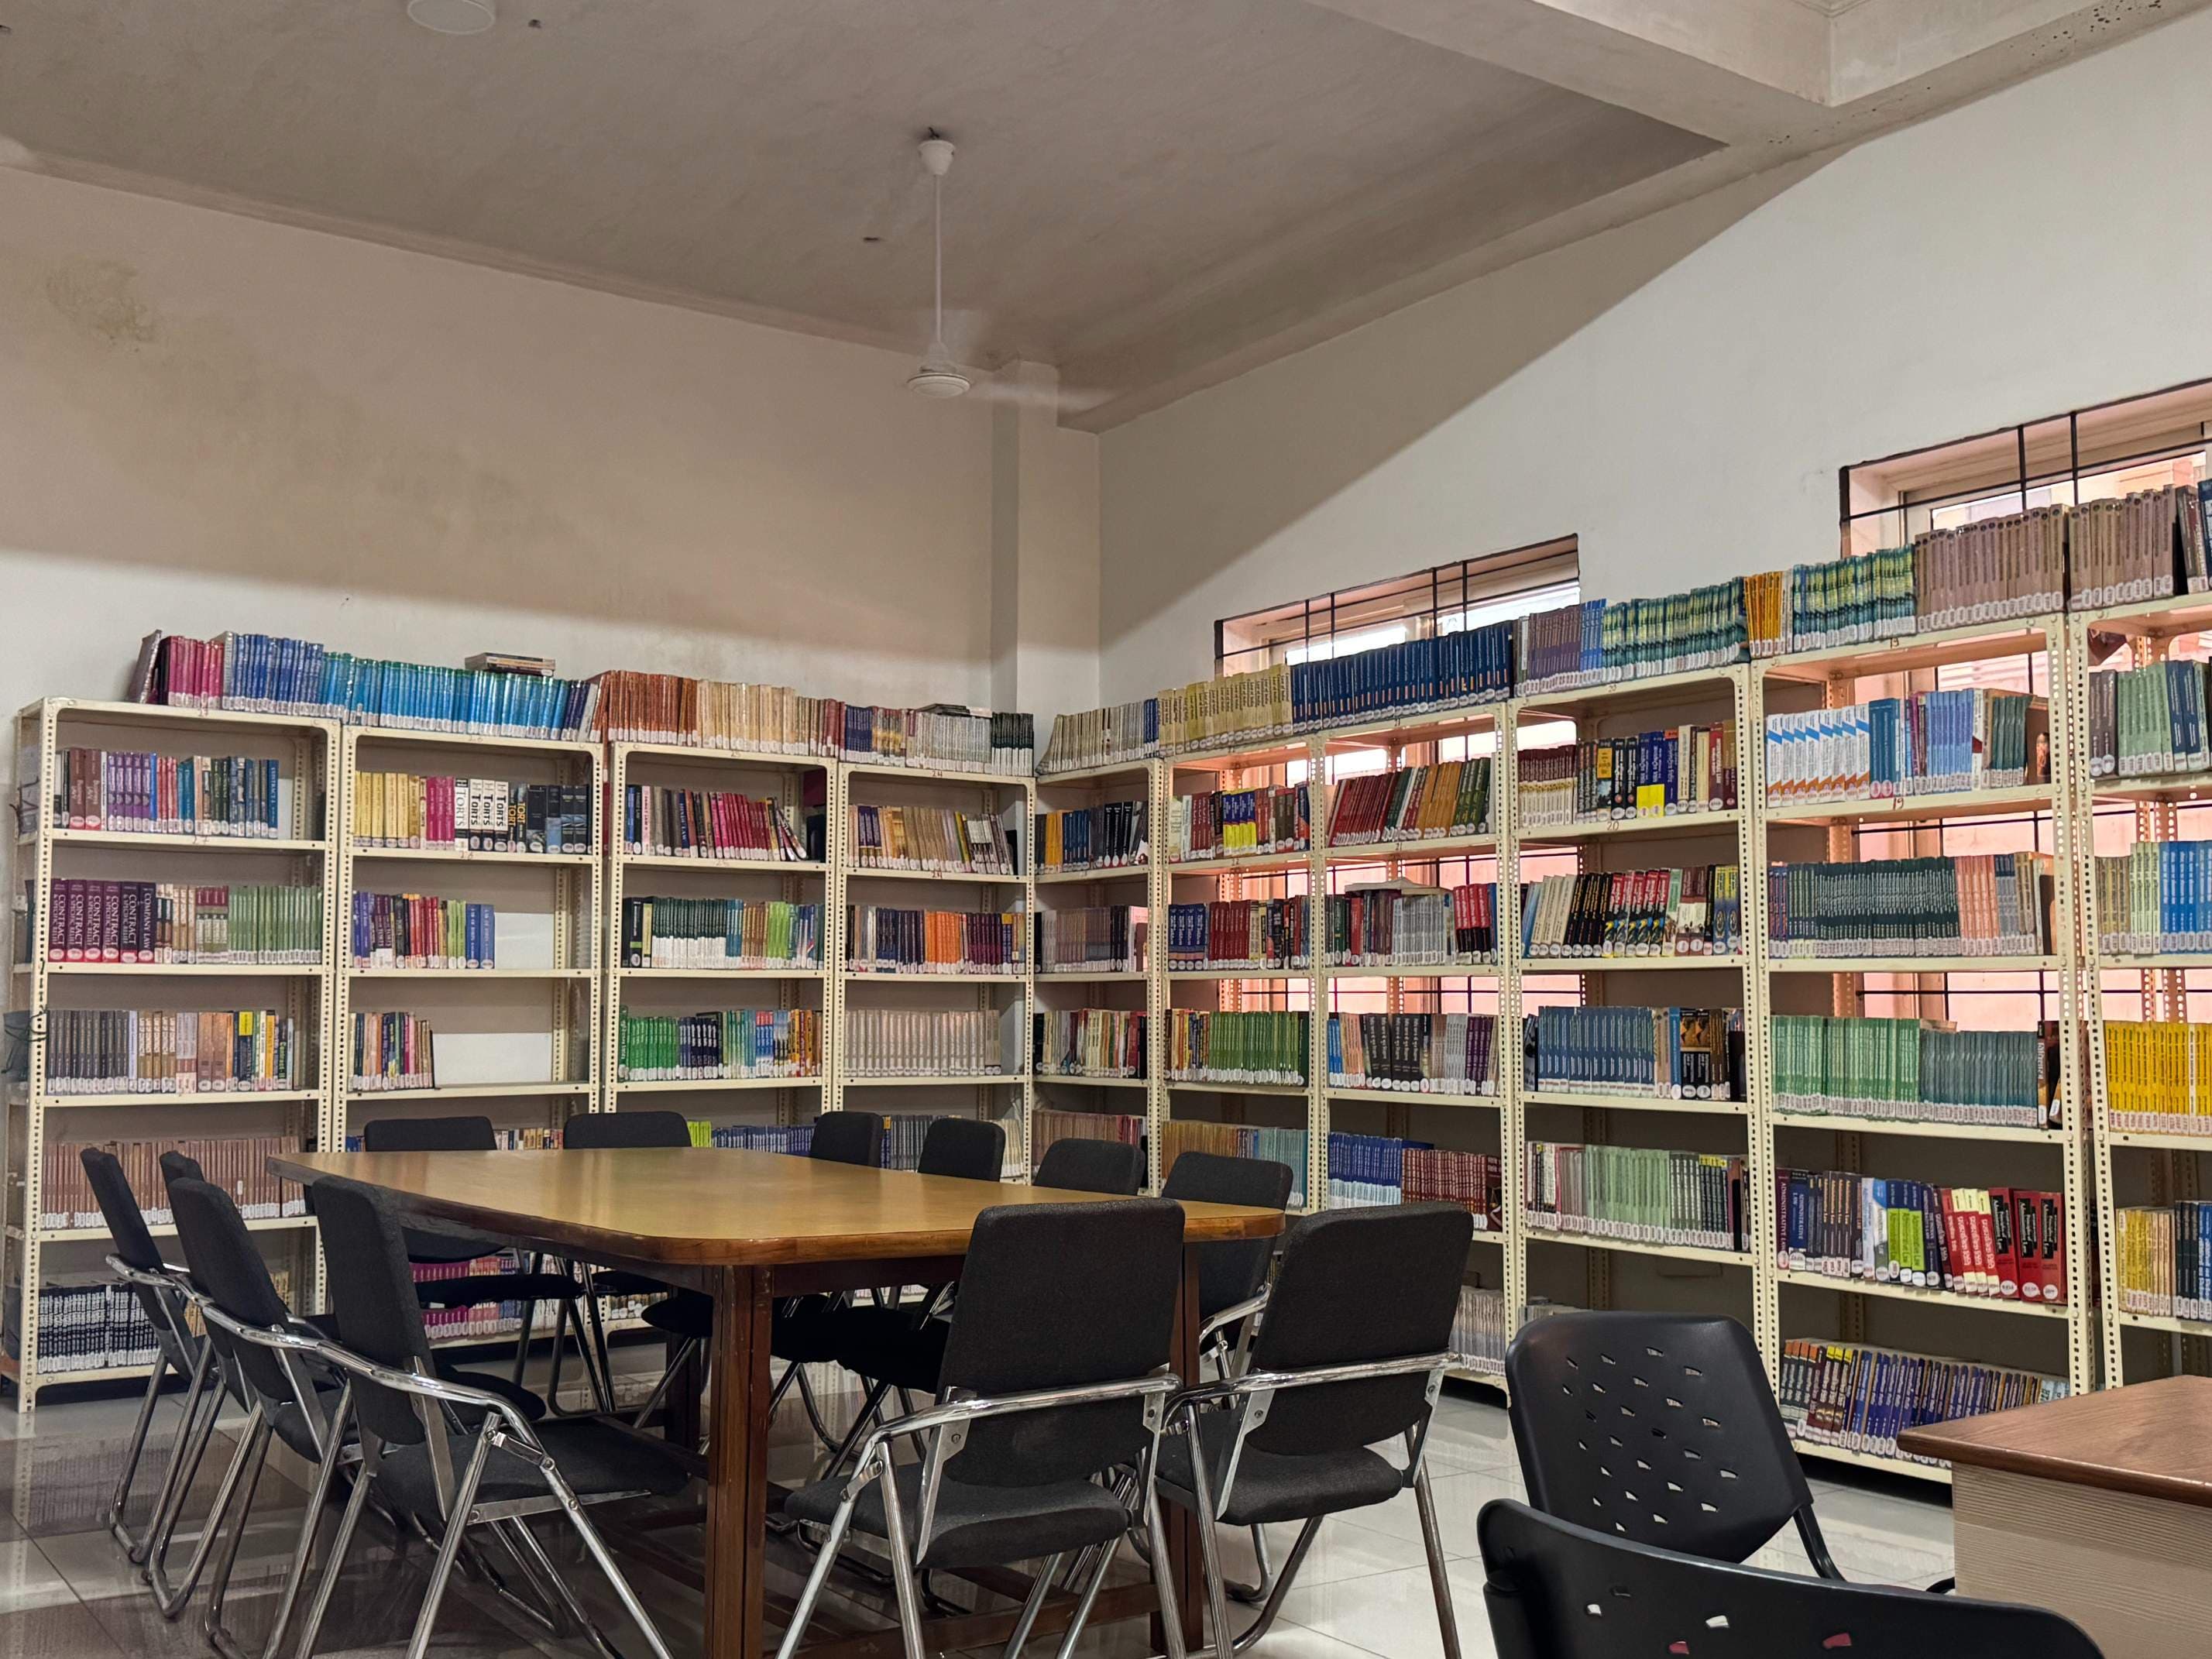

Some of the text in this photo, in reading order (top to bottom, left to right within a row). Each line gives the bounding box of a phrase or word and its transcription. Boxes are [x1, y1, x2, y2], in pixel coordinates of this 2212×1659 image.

[455, 789, 466, 826] TORTS
[508, 805, 517, 827] TORT
[517, 802, 526, 824] TORT
[1893, 798, 1904, 809] 19
[1607, 821, 1618, 831] 20
[57, 894, 66, 945] CONTRACT
[75, 894, 84, 946] CONTRACT
[93, 895, 101, 946] CONTRACT
[129, 894, 137, 945] CONTRACT
